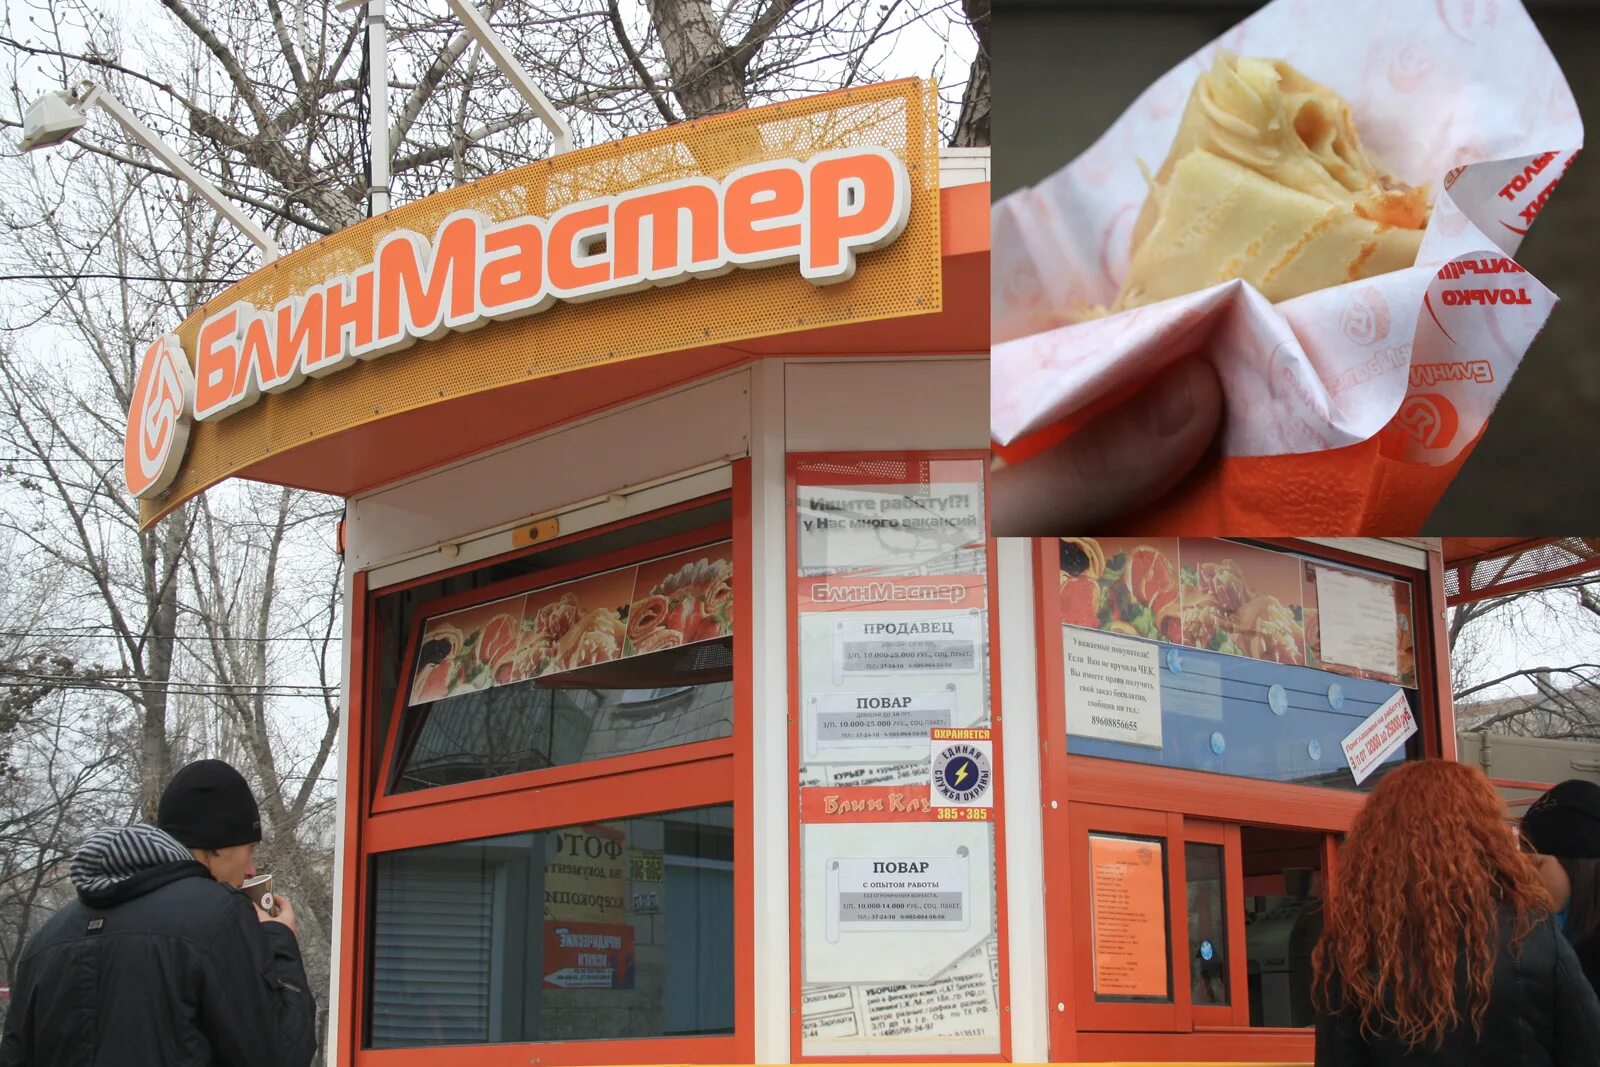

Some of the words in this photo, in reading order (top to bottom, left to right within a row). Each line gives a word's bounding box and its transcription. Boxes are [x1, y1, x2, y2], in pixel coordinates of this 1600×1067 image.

[196, 149, 905, 412] БлинМастер
[1441, 288, 1532, 306] ТОЛЬКО
[1408, 360, 1494, 387] БлинМ
[808, 498, 877, 512] Ищите
[816, 518, 846, 529] Нас
[849, 517, 899, 529] много
[902, 514, 977, 528] вакансий
[811, 581, 966, 604] БлинМастер
[863, 622, 954, 635] ПРОДАВЕЦ
[1073, 637, 1110, 651] Уважаемые
[1111, 646, 1150, 659] покупатели!
[1068, 653, 1084, 663] Если
[1087, 656, 1100, 667] Вам
[1110, 662, 1137, 673] вручили
[1138, 664, 1156, 677] ЧЕК,
[1070, 667, 1081, 677] Вы
[1082, 671, 1104, 681] имеете
[1105, 675, 1125, 685] право
[1125, 678, 1154, 690] получить
[1079, 684, 1094, 693] свой
[1096, 687, 1112, 696] заказ
[1113, 688, 1147, 702] бесплатно,
[856, 696, 912, 709] ПОВАР
[1087, 699, 1115, 711] сообщив
[1116, 704, 1125, 712] по
[840, 720, 891, 728] 10.000-25.000
[1091, 715, 1138, 731] 89608856655
[934, 729, 990, 740] ОХРАНЯЕТСЯ
[942, 745, 982, 760] ЕДИНАЯ
[934, 769, 961, 802] СЛУЖБА
[963, 770, 989, 801] ОХРАНЫ
[823, 792, 885, 815] Блин
[888, 792, 932, 814] Клу
[873, 862, 930, 874] ПОВАР
[870, 881, 906, 889] ОПЫТОМ
[907, 881, 940, 889] РАБОТЫ
